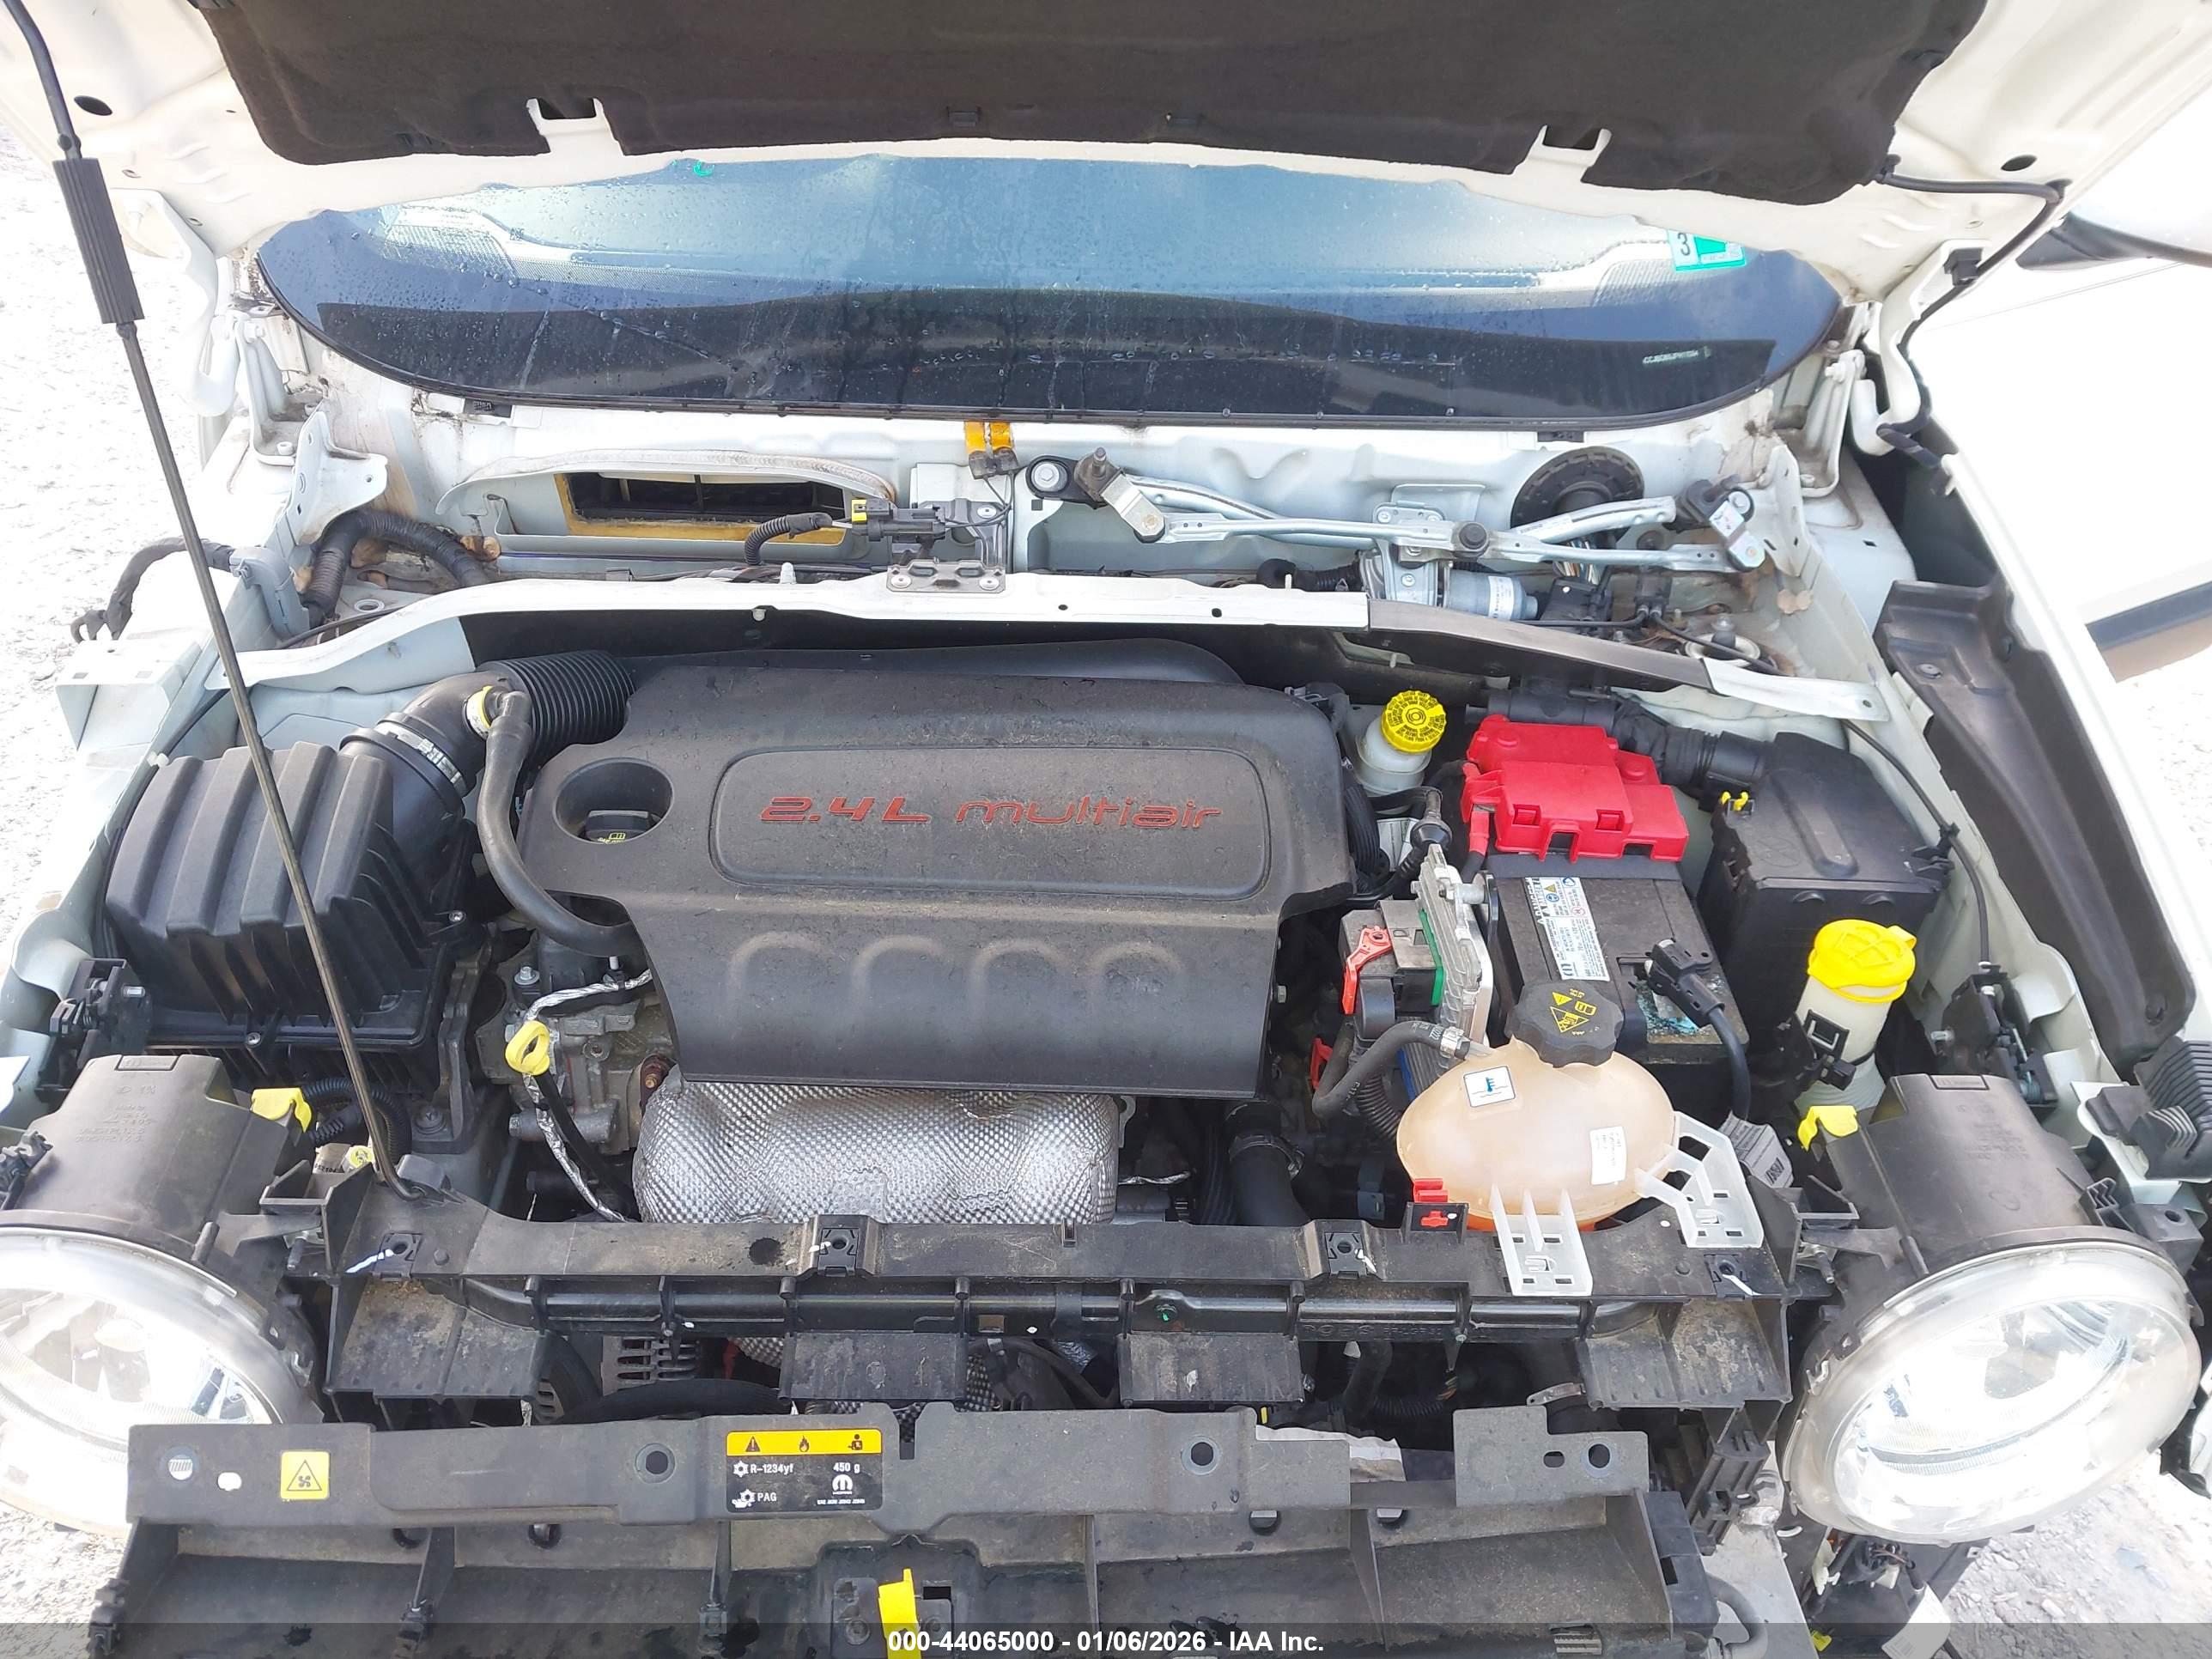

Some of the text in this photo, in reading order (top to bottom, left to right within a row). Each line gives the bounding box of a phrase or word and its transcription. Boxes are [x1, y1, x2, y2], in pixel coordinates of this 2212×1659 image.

[954, 795, 1223, 830] multiair
[750, 1462, 860, 1475] R-1234yf 450 g
[757, 1492, 777, 1502] PAG
